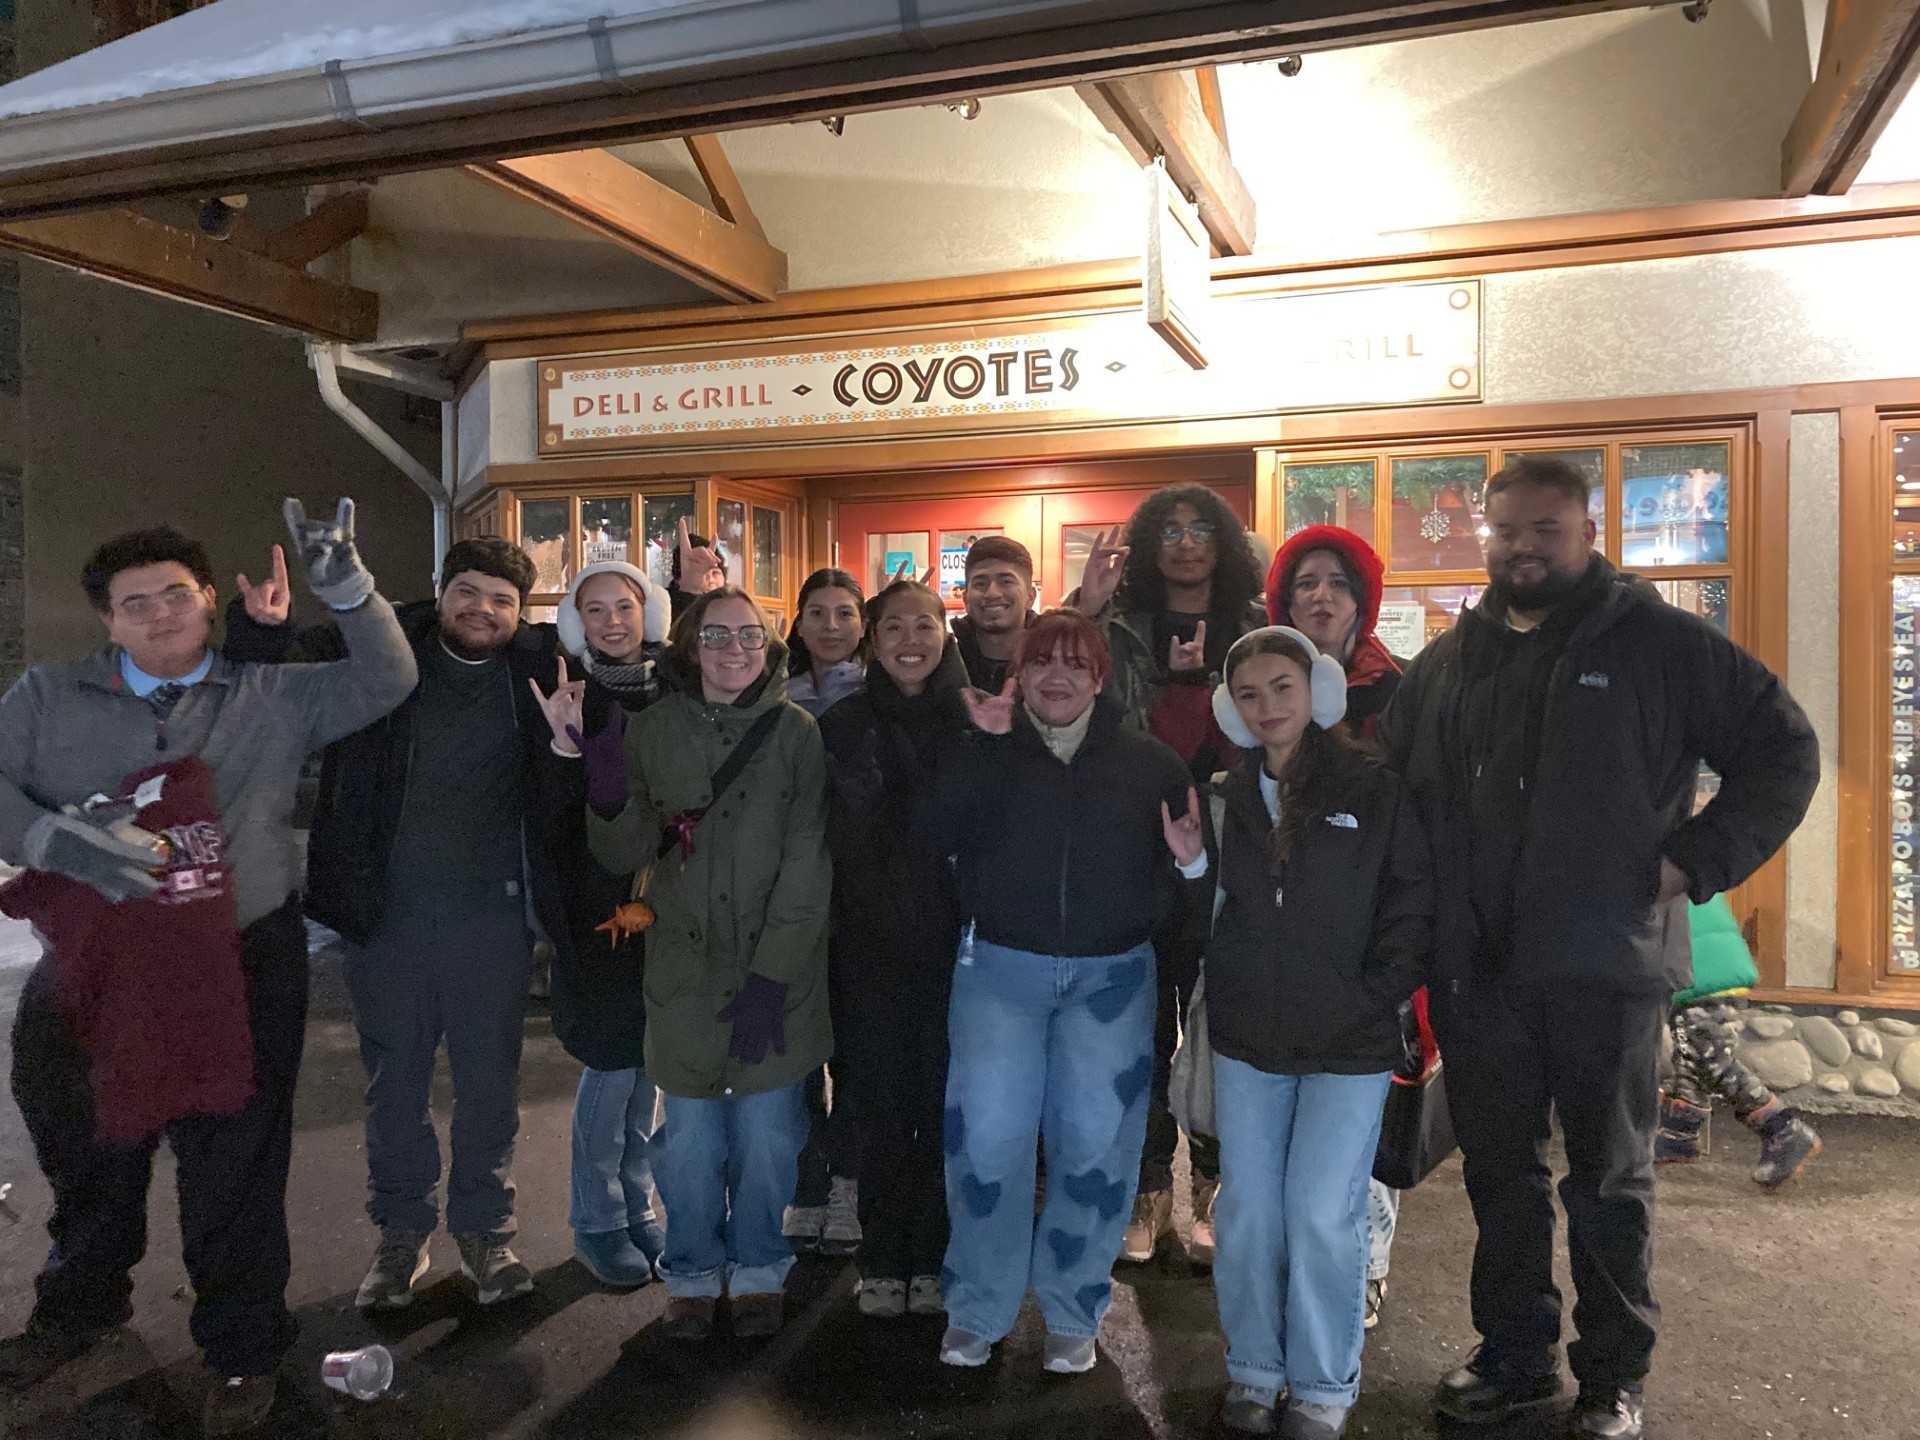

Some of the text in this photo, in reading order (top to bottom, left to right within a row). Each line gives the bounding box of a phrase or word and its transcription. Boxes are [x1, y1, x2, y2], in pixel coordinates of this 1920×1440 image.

[573, 393, 641, 417] DELI
[652, 394, 669, 413] &
[678, 384, 773, 410] GRILL
[833, 347, 1080, 408] COYOTES
[941, 554, 966, 570] CLOS
[1892, 676, 1914, 716] EYE
[1892, 720, 1914, 762] RIB
[1892, 881, 1914, 947] PIZZA
